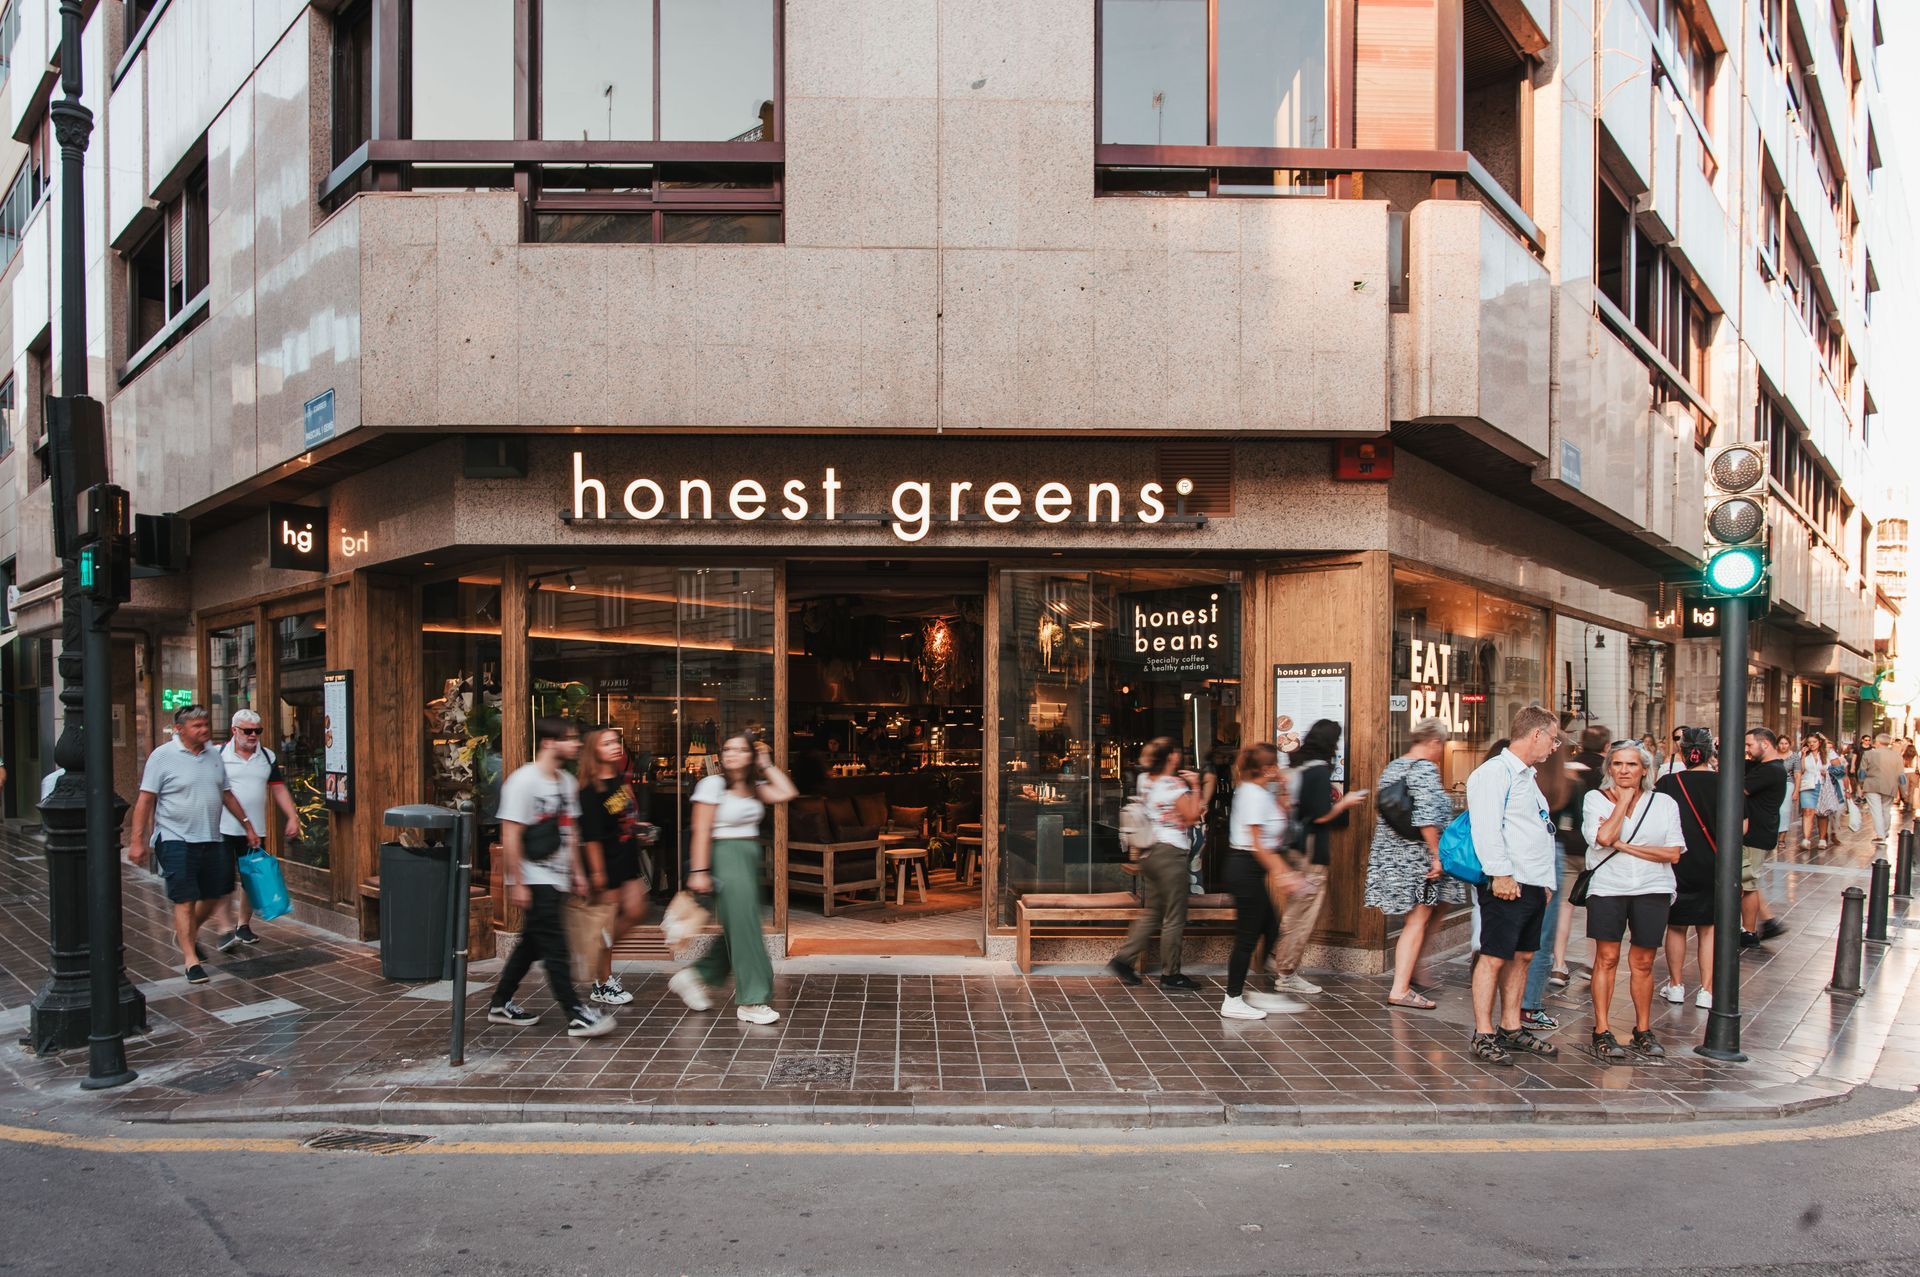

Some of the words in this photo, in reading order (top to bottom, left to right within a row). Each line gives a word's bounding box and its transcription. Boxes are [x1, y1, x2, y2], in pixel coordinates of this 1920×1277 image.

[572, 451, 841, 520] honest
[1135, 602, 1219, 628] honest
[1135, 629, 1219, 653] beans
[1146, 656, 1180, 666] Specialty
[1181, 655, 1205, 664] coffee
[1151, 663, 1178, 673] healthy
[1180, 663, 1209, 672] endings
[1277, 667, 1307, 676] honest
[1410, 638, 1452, 686] EAT
[1410, 689, 1470, 733] REAL.
